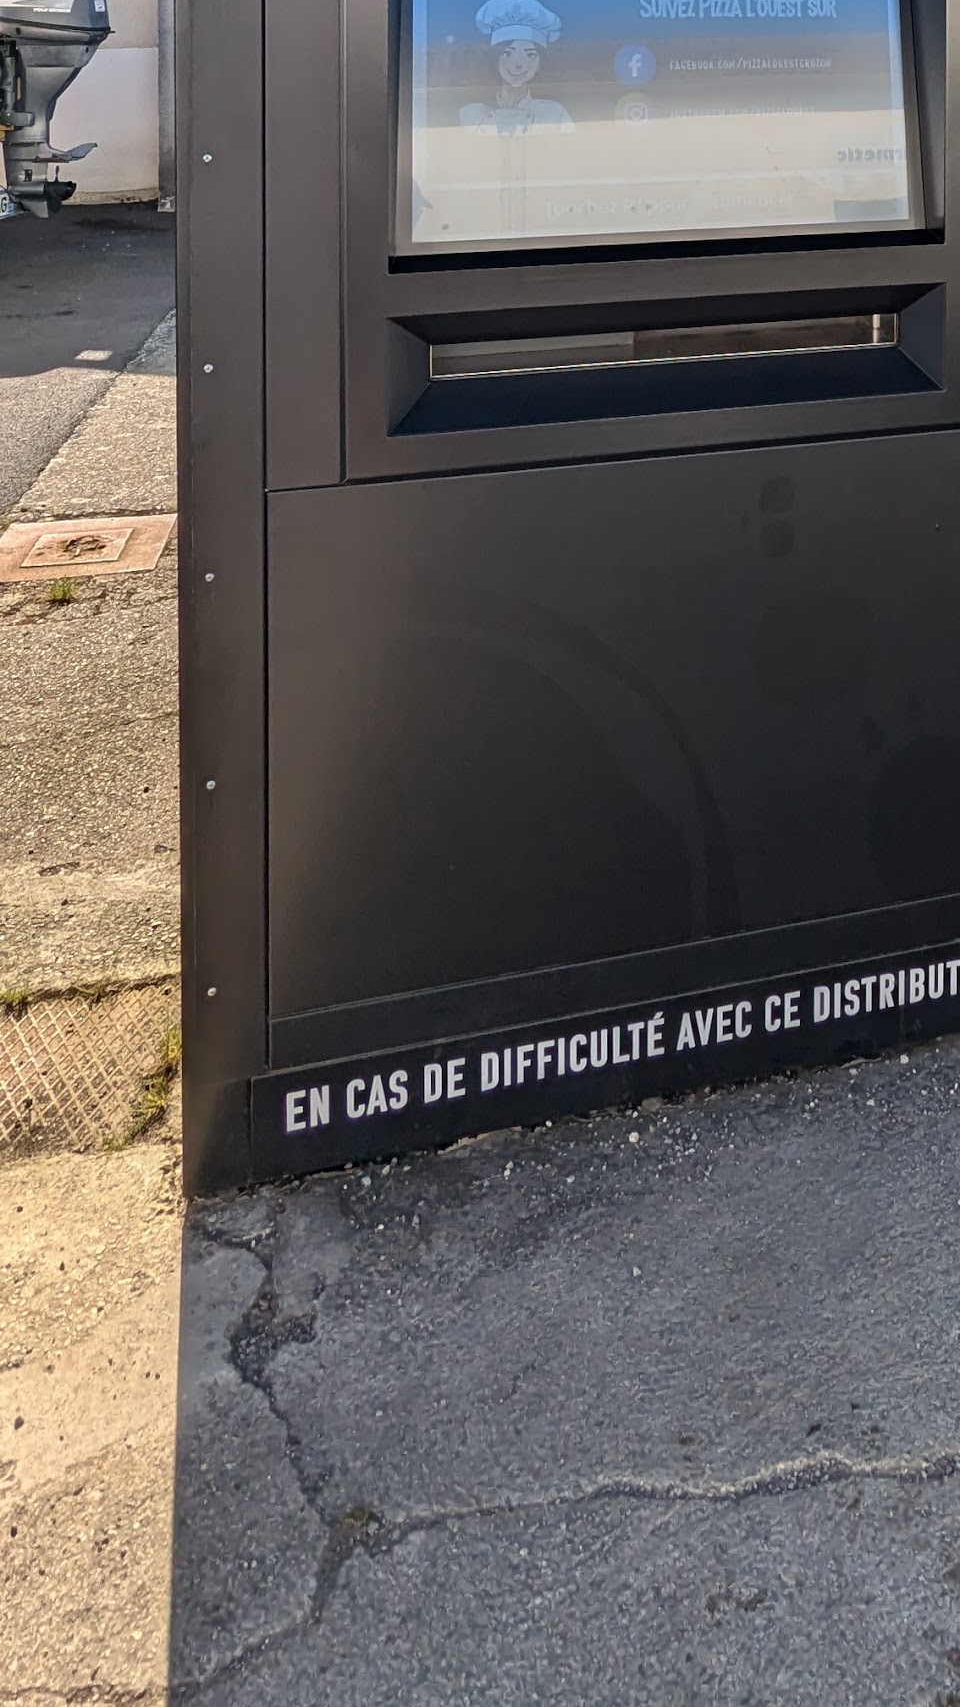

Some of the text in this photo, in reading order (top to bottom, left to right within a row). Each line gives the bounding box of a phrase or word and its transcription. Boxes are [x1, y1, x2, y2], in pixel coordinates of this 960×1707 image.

[285, 1084, 331, 1133] EN
[345, 1069, 409, 1120] CAS
[423, 1057, 467, 1105] DE
[480, 1010, 666, 1093] DIFFICULTÉ
[675, 1000, 753, 1052] AVEC
[764, 990, 801, 1033] CE
